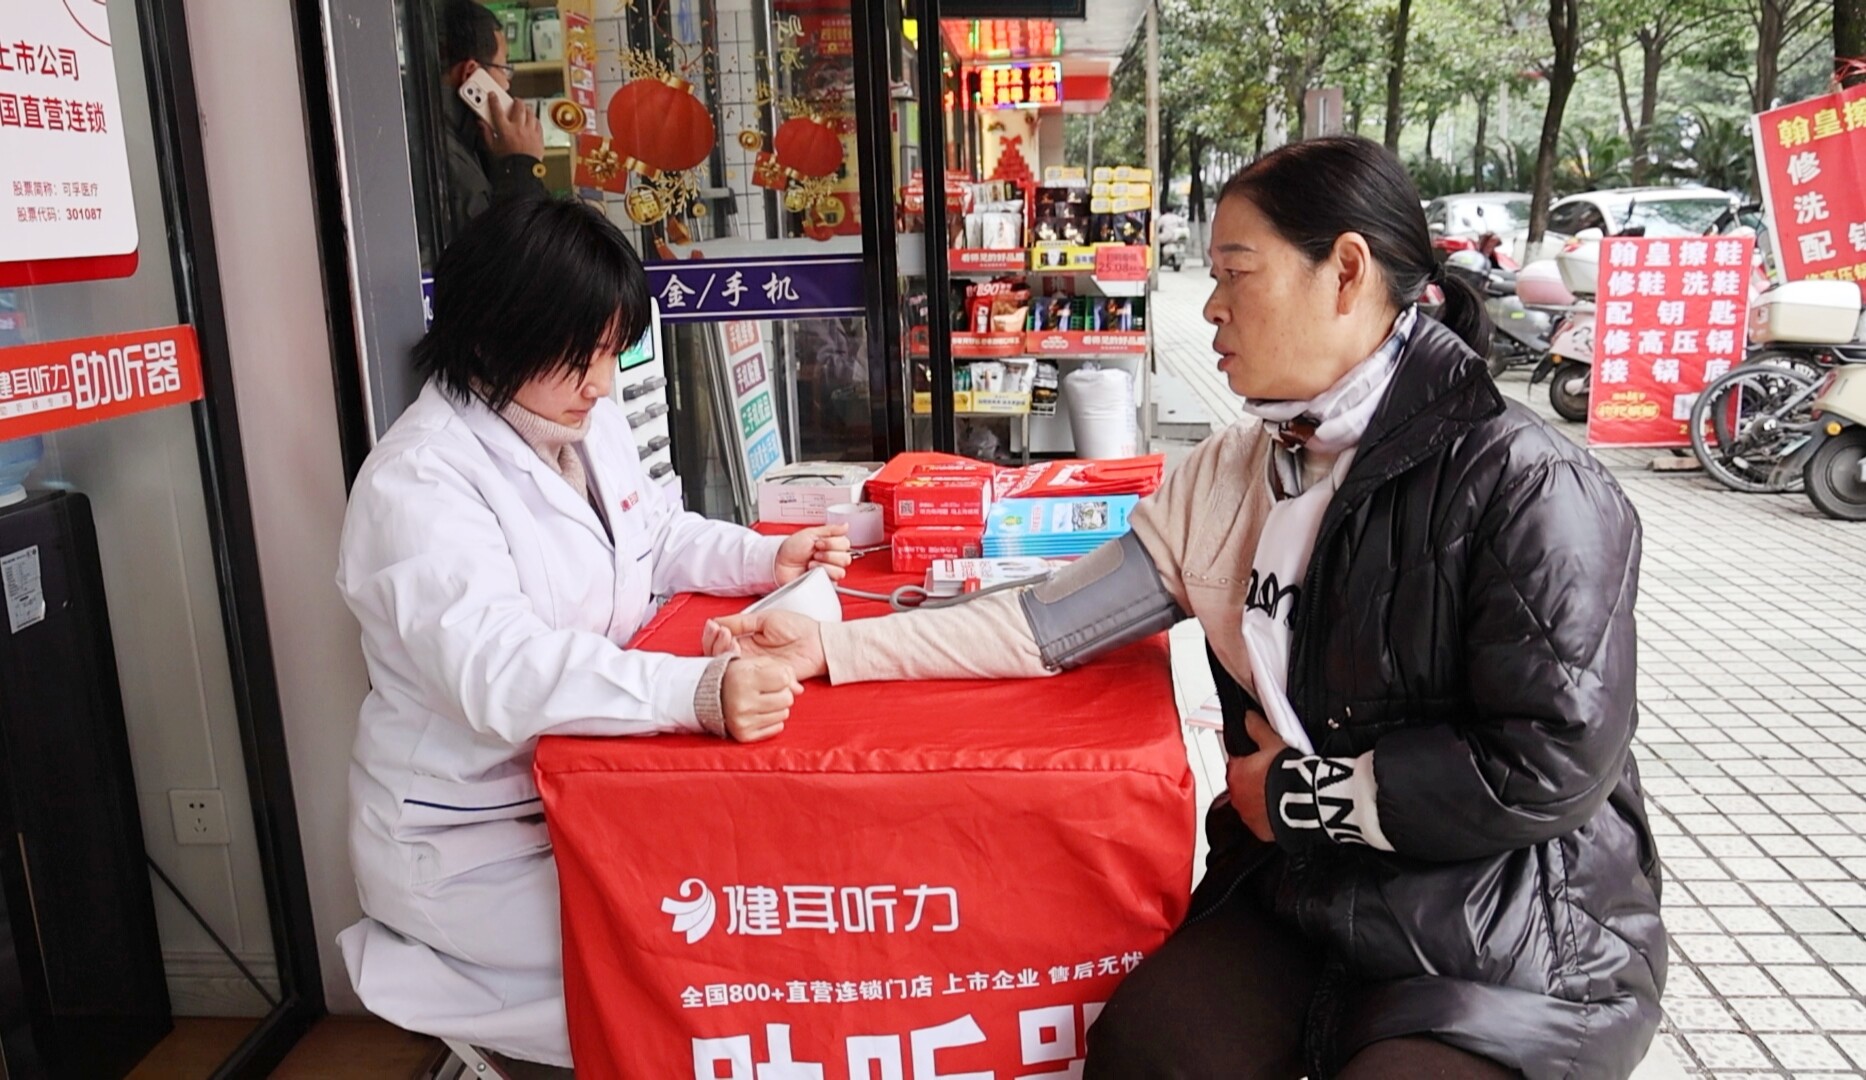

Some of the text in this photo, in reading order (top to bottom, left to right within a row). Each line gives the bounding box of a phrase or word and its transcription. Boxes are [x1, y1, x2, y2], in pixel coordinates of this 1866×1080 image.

[629, 188, 662, 222] 福
[1608, 240, 1744, 268] 翰皇擦鞋
[1606, 270, 1741, 297] 修鞋 洗鞋
[1604, 301, 1737, 326] 配钥匙
[1602, 329, 1735, 355] 修高压锅
[71, 340, 181, 410] 助听器
[722, 884, 959, 936] 健耳听力
[680, 950, 1145, 1009] 全国800+直营连锁门店 上市企业 售后无忧
